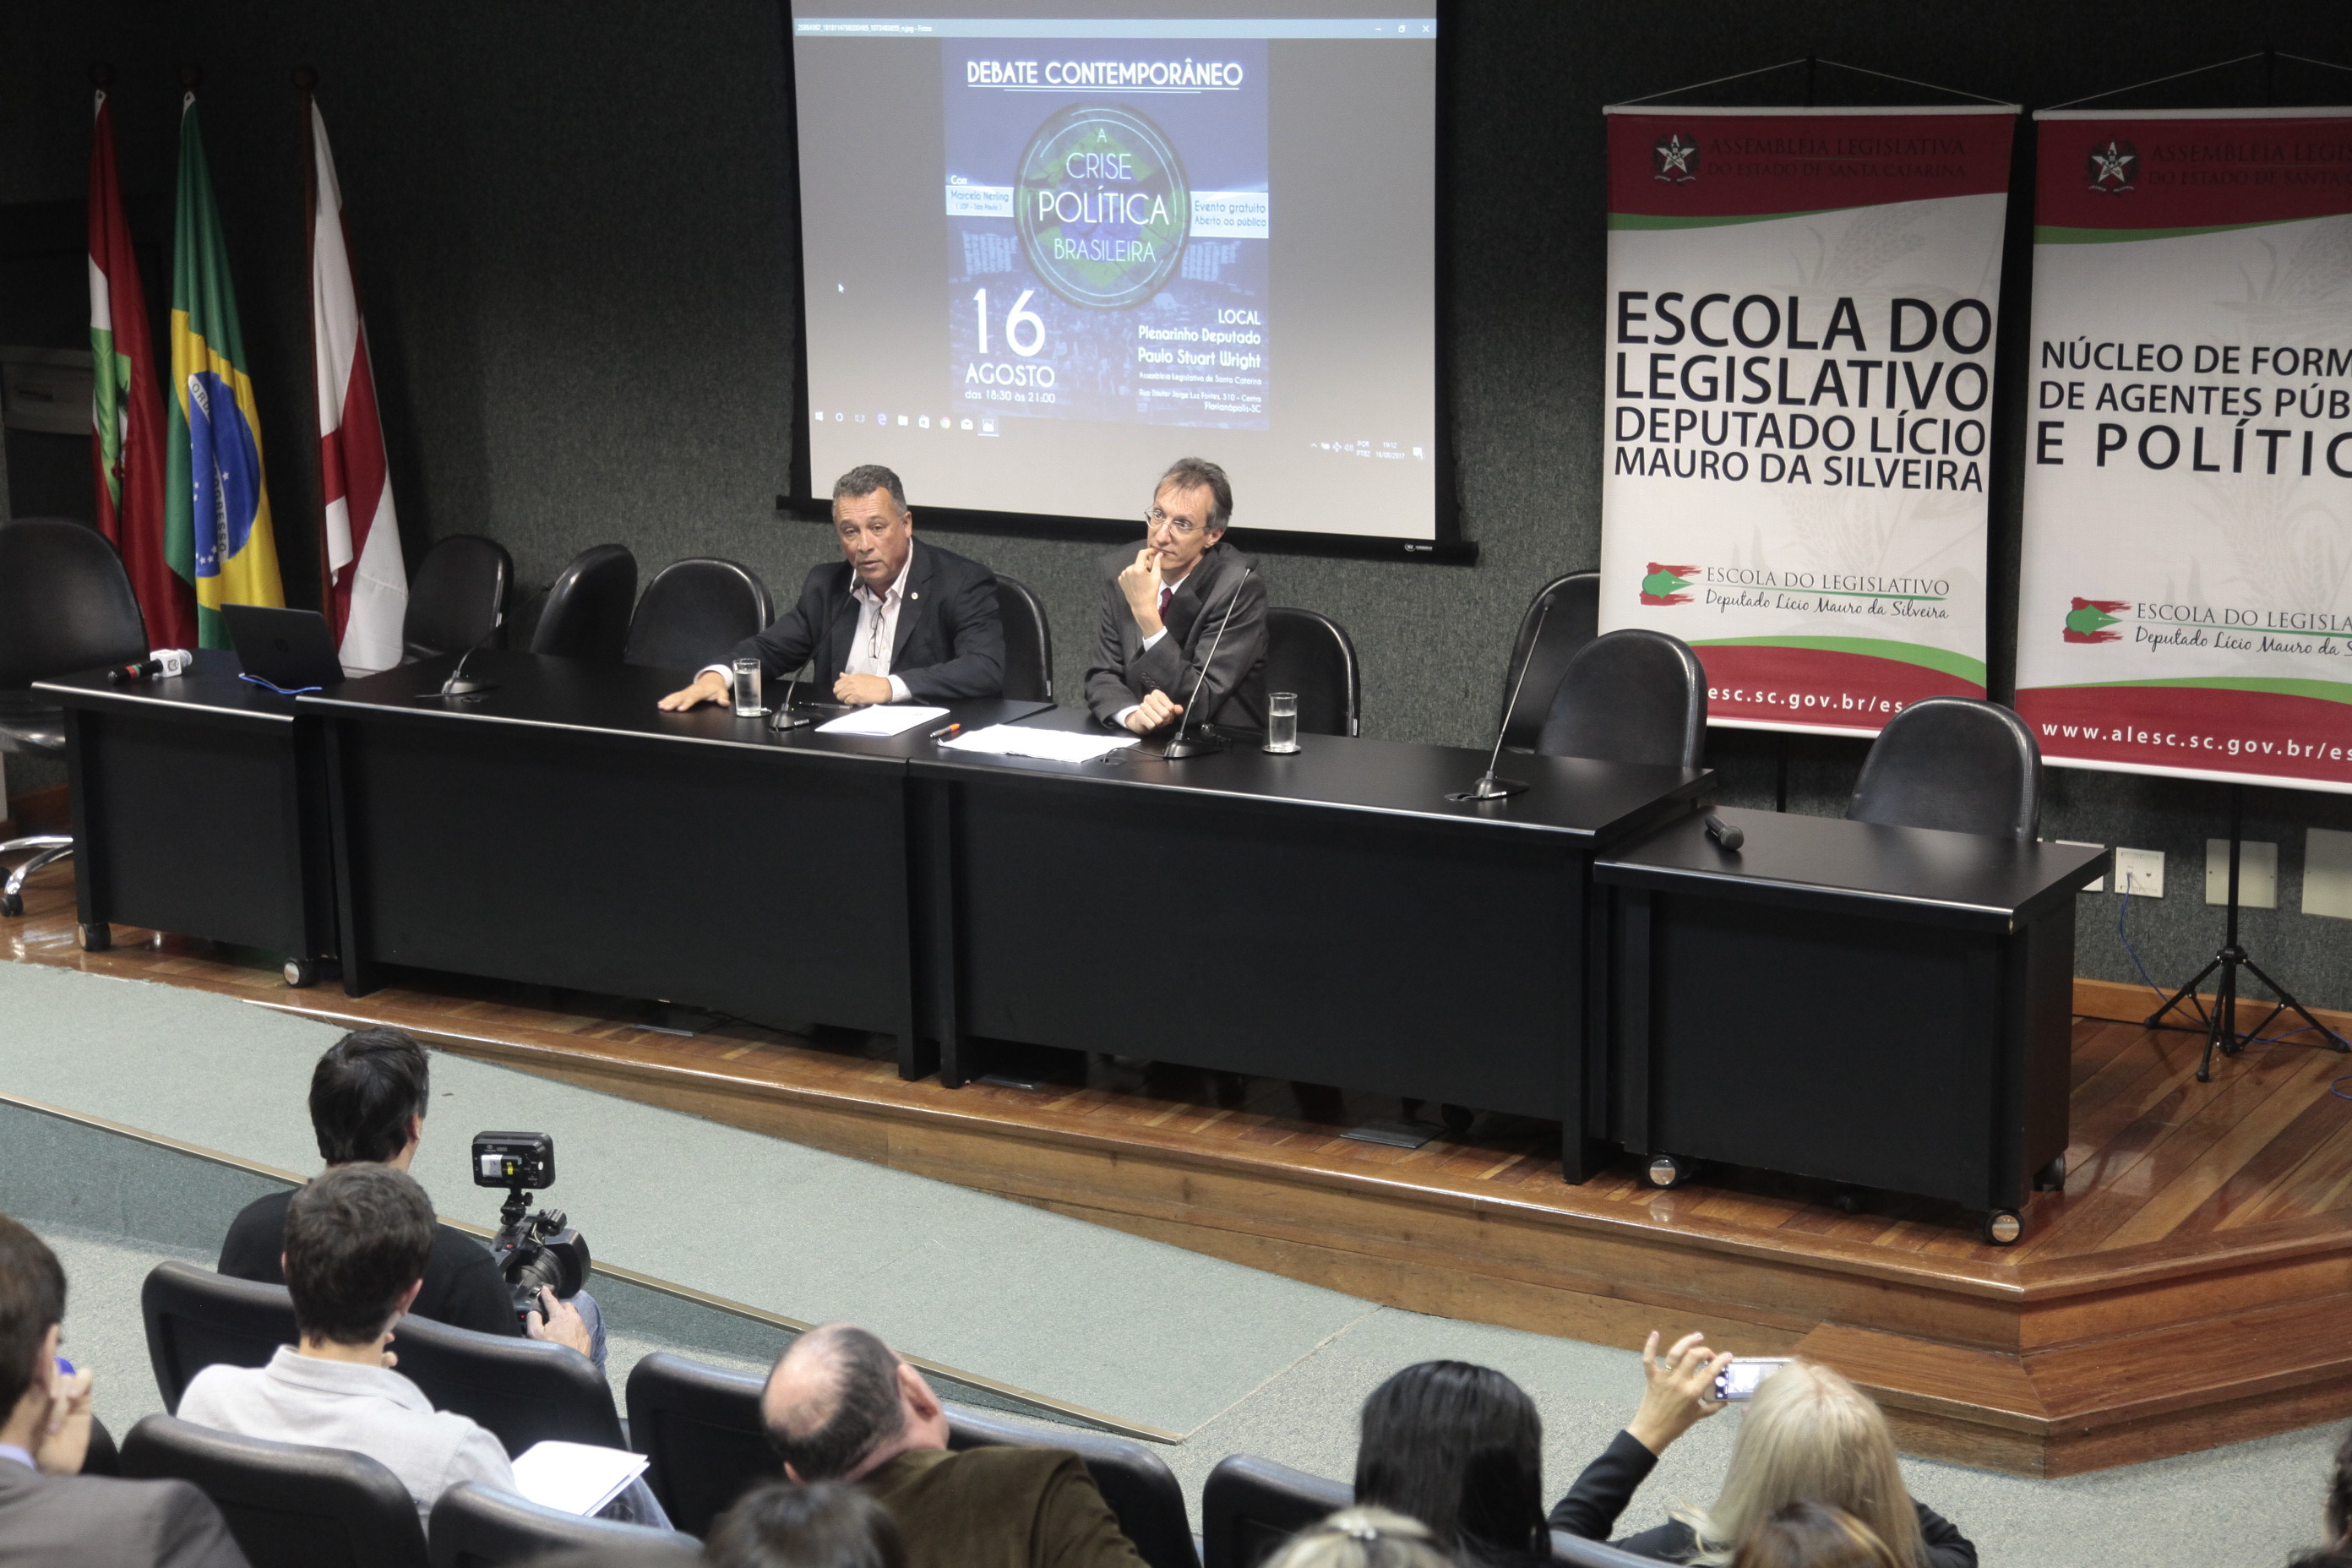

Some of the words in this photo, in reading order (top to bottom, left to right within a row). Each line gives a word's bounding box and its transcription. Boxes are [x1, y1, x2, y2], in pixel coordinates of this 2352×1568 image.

[967, 62, 1037, 83] DEBATE
[1045, 58, 1243, 85] CONTEMPORÂNEO
[1097, 128, 1107, 142] A
[1709, 138, 1828, 155] ASSEMBLEIA
[1838, 139, 1965, 155] LEGISLATIVA
[1066, 152, 1131, 180] CRISE
[2152, 144, 2285, 161] ASSEMBLEIA
[950, 175, 967, 185] Com
[1708, 163, 1731, 176] DO
[1738, 163, 1792, 176] ESTADO
[1802, 164, 1823, 177] DE
[1829, 163, 1878, 177] SANTA
[1884, 163, 1966, 177] CATARINA
[2148, 171, 2175, 184] DO
[2181, 171, 2249, 184] ESTADO
[2284, 172, 2340, 184] SANTA
[1038, 186, 1169, 225] POLÍTICA
[1195, 200, 1225, 213] Evento
[1229, 202, 1266, 215] gratuito
[1195, 217, 1221, 226] Aberto
[1237, 217, 1266, 228] público
[1054, 238, 1156, 263] BRASILEIRA
[973, 288, 1046, 357] 16
[1218, 309, 1261, 325] LOCAL
[1617, 291, 1867, 351] ESCOLA
[1890, 297, 1992, 355] DO
[1139, 324, 1199, 341] Plenarinho
[1201, 328, 1261, 345] Deputado
[1138, 346, 1173, 363] Paulo
[1177, 349, 1216, 365] Stuart
[1219, 351, 1261, 370] Wright
[2041, 335, 2184, 373] NÚCLEO
[2194, 345, 2240, 374] DE
[2251, 346, 2352, 378] FORM
[965, 362, 1055, 388] AGOSTO
[1616, 351, 1989, 411] LEGISLATIVO
[965, 389, 982, 399] das
[987, 389, 1011, 400] 18:30
[1028, 392, 1055, 403] 21:00
[2039, 380, 2085, 411] DE
[2095, 383, 2262, 416] AGENTES
[2274, 383, 2350, 420] PÚB
[1614, 406, 1856, 451] DEPUTADO
[1870, 410, 1986, 457] LÍCIO
[2036, 420, 2065, 466] E
[2096, 417, 2352, 479] POLÍTIC
[1614, 446, 1749, 482] MAURO
[1760, 452, 1812, 485] DA
[1823, 455, 1984, 493] SILVEIRA
[1707, 567, 1778, 586] ESCOLA
[1784, 571, 1814, 589] DO
[1822, 574, 1950, 596] LEGISLATIVO
[1706, 589, 1770, 613] Deputado
[1775, 593, 1810, 612] Lício
[1814, 596, 1862, 615] Mauro
[1867, 597, 1887, 616] da
[1891, 598, 1949, 619] Silveira
[2137, 603, 2216, 623] ESCOLA
[2224, 608, 2258, 627] DO
[2268, 612, 2352, 632] LEGISLA
[2135, 626, 2208, 652] Deputado
[2213, 631, 2252, 651] Lício
[2256, 636, 2312, 656] Mauro
[2318, 637, 2340, 656] da
